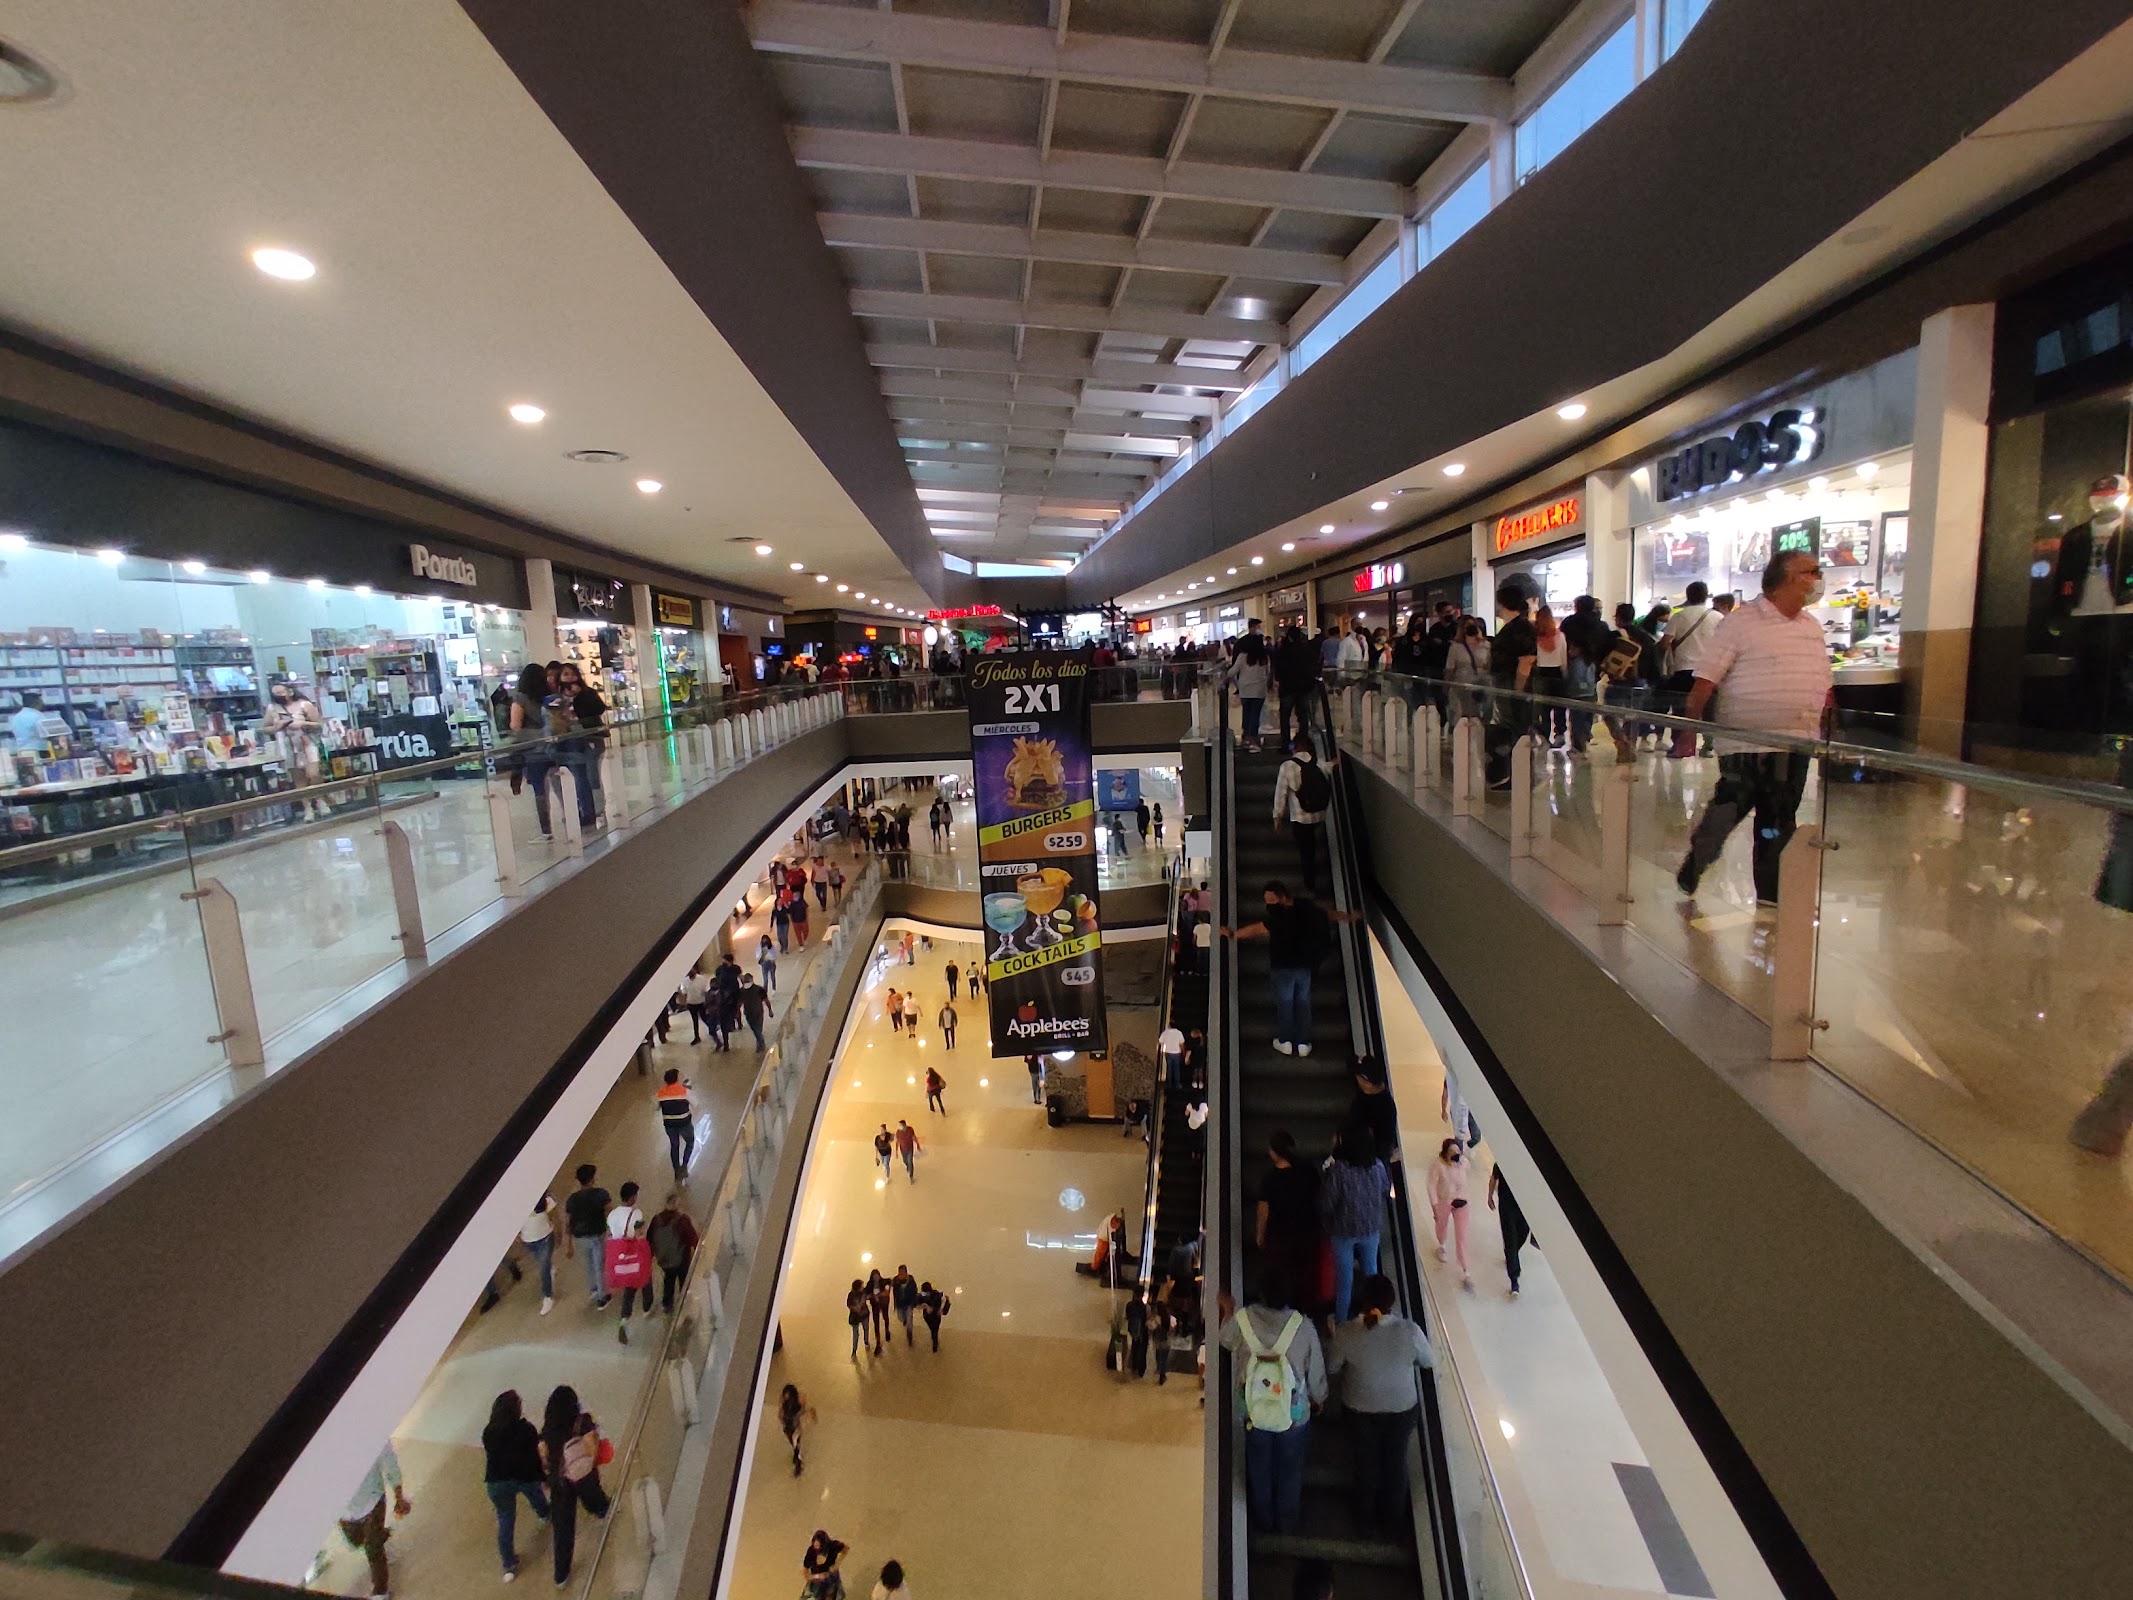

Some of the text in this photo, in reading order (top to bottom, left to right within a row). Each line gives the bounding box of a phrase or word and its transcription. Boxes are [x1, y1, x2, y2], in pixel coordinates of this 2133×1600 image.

[410, 544, 477, 586] Porrúa
[972, 660, 1026, 689] Todos
[1032, 660, 1053, 678] los
[1005, 684, 1060, 714] 2X1
[1002, 807, 1072, 838] BURGERS
[1049, 835, 1082, 848] $259
[991, 864, 1028, 876] JUEVES
[1003, 938, 1085, 974] COCKTAILS
[1007, 1017, 1089, 1038] Applebee's
